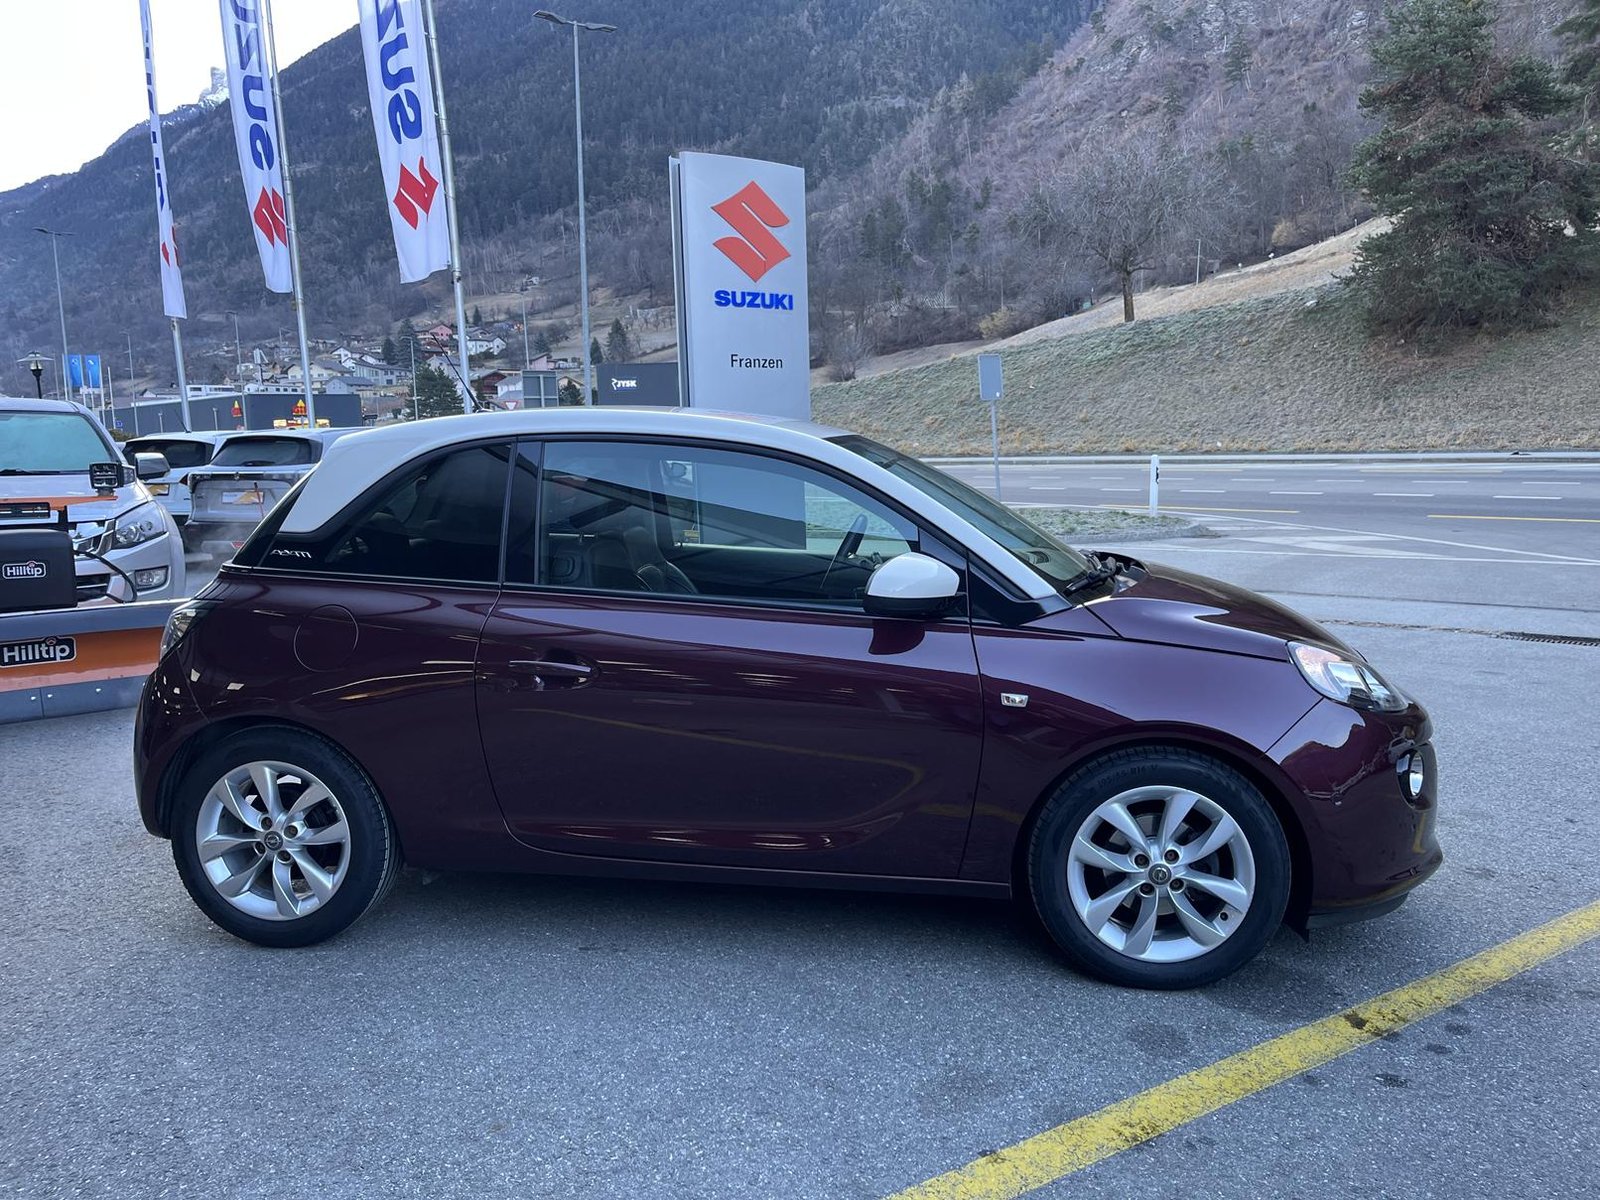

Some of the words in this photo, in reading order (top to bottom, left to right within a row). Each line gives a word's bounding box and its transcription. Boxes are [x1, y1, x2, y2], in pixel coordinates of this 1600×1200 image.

[714, 289, 794, 311] SUZUKI
[730, 353, 783, 369] Franzen
[616, 379, 638, 388] JYSK
[6, 565, 43, 577] Hilltip
[3, 642, 71, 663] Hilltip
